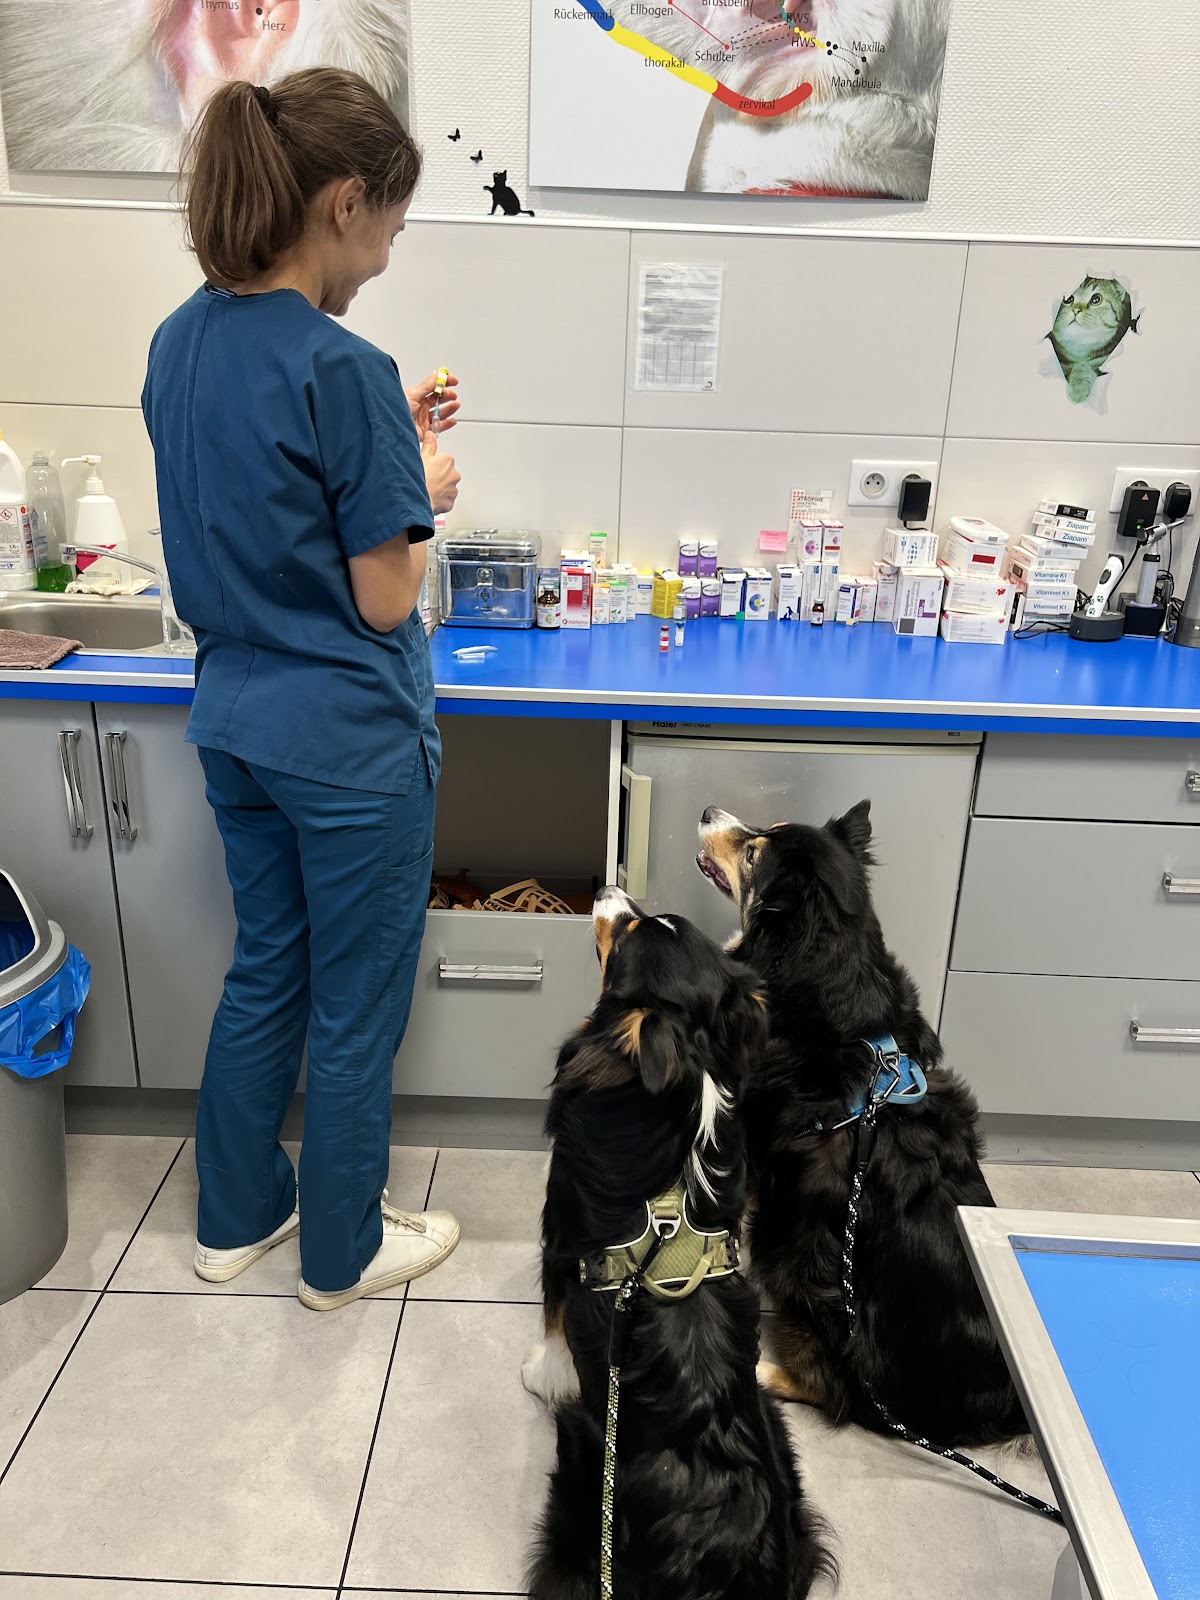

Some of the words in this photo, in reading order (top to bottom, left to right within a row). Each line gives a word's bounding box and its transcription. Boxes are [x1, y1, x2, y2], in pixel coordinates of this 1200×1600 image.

[200, 0, 239, 11] Thymus
[630, 3, 674, 18] Ellbogen
[554, 8, 615, 20] Rückenmark
[262, 20, 286, 31] Herz
[791, 36, 816, 48] HWS
[852, 41, 885, 53] Maxilla
[644, 56, 686, 68] thorakal
[695, 50, 736, 62] Schulter
[831, 76, 882, 89] Mandibula
[738, 98, 776, 110] zervikal
[1066, 520, 1089, 531] Ziapam
[1062, 532, 1088, 543] Ziapam
[652, 720, 677, 728] Haier
